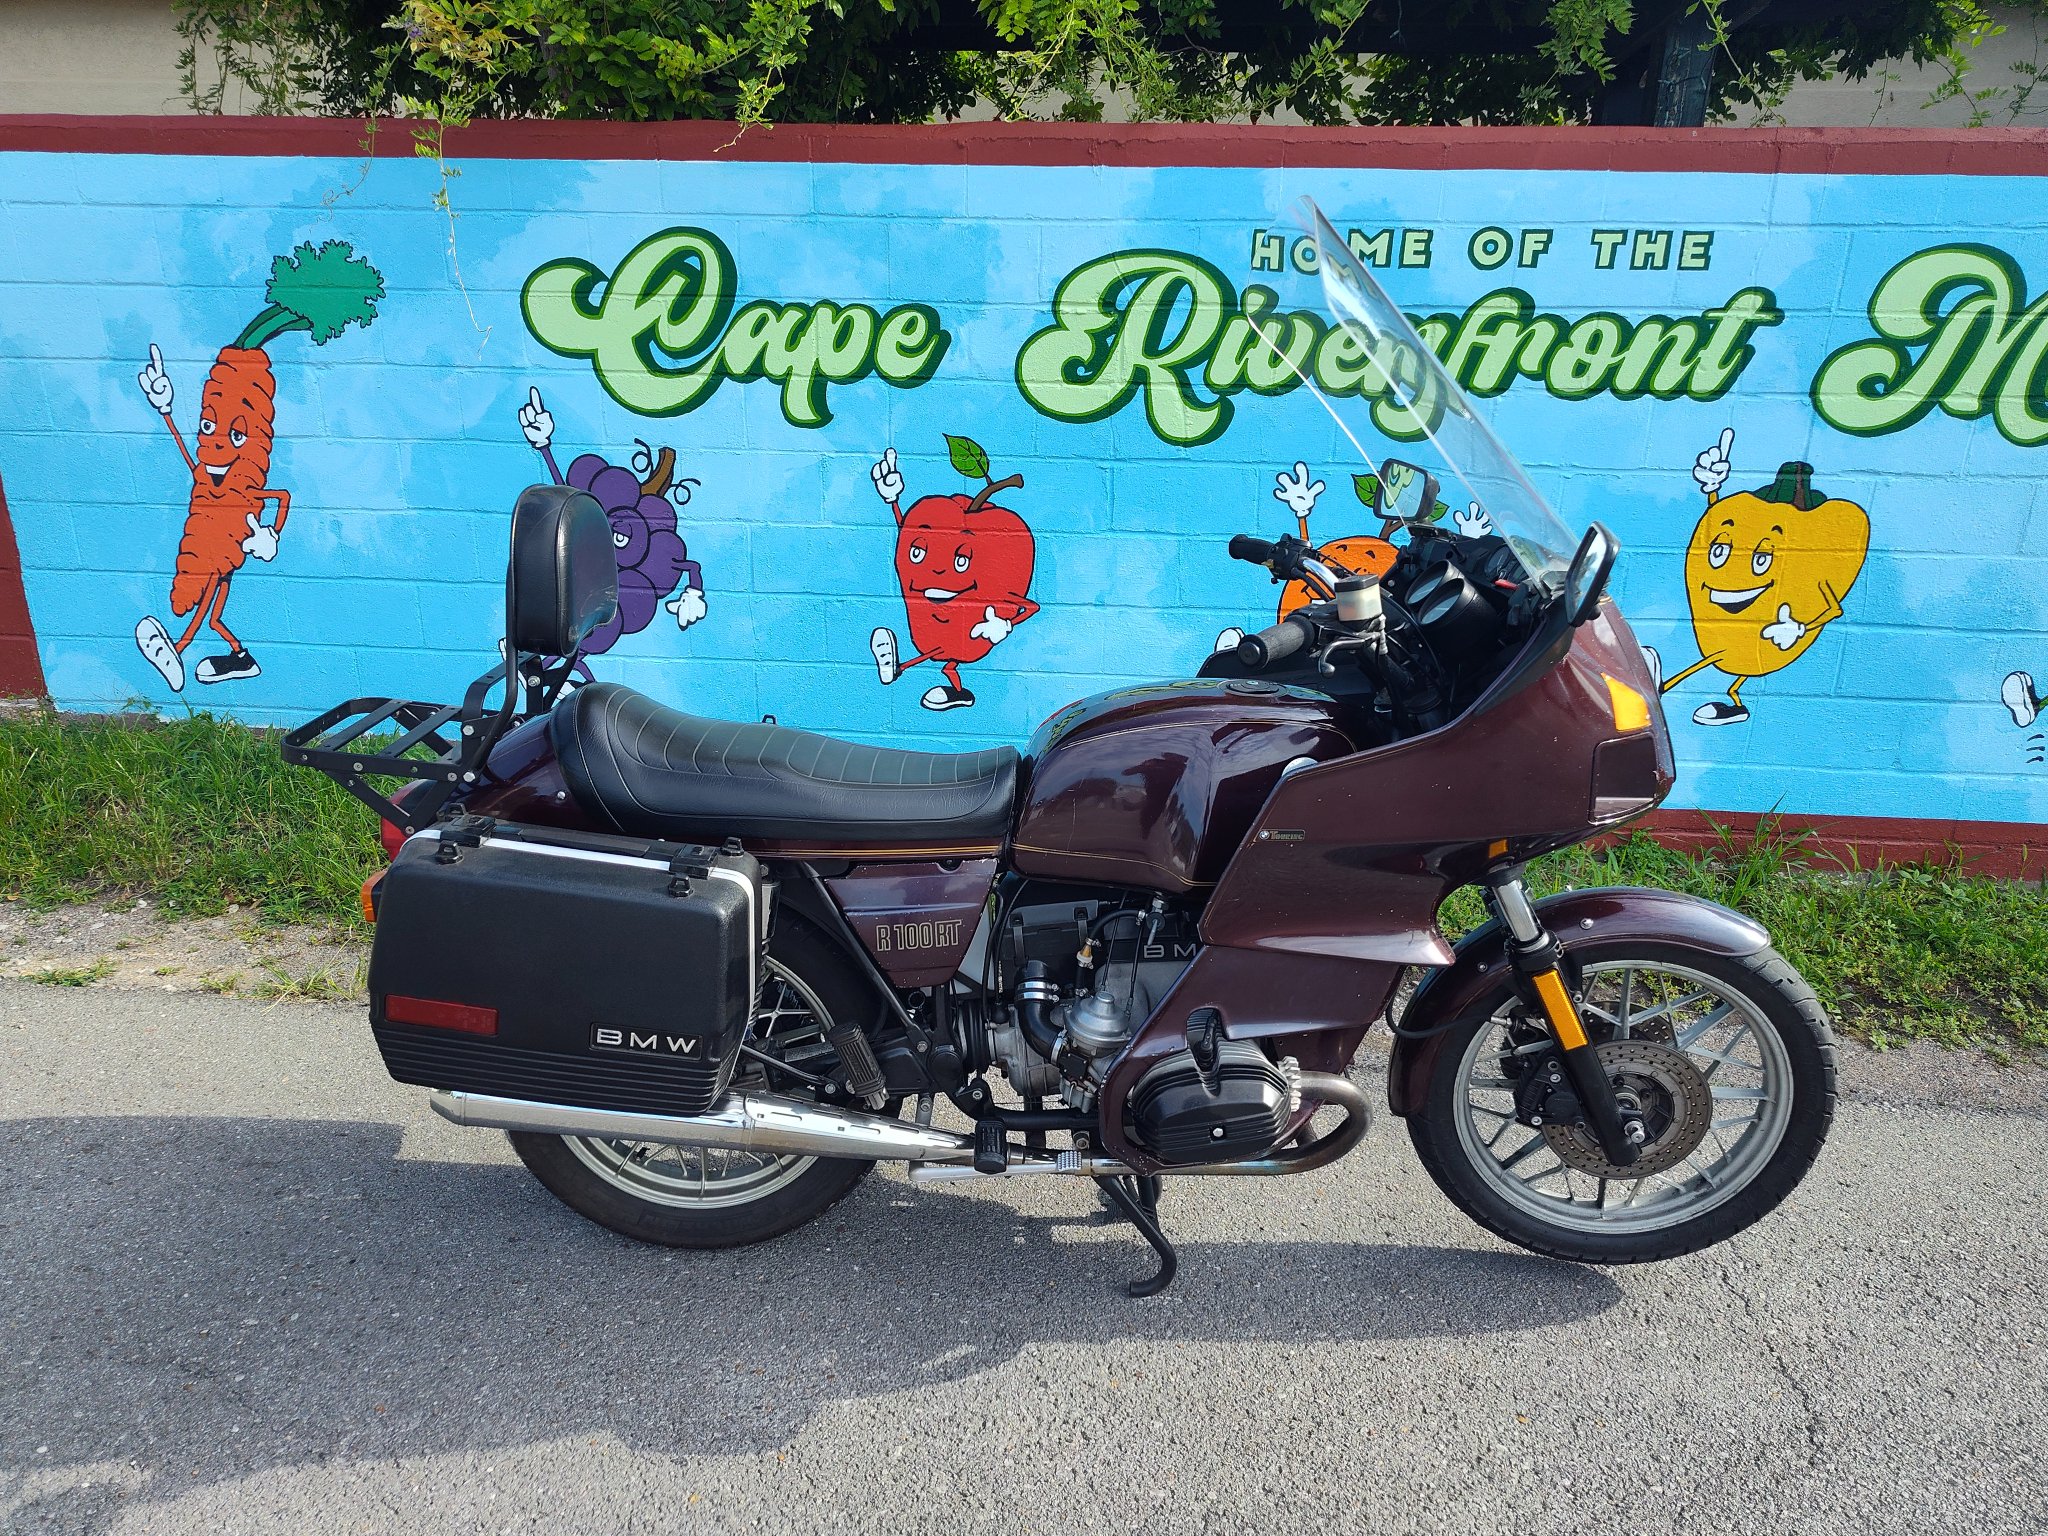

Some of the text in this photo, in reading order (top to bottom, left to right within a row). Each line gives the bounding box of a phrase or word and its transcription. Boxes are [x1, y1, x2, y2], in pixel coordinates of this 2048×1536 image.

[1252, 226, 1715, 276] HOME OF THE
[520, 226, 950, 428] Cape
[876, 919, 962, 951] R 100RT
[1143, 943, 1197, 959] BM
[596, 1028, 697, 1054] BMW
